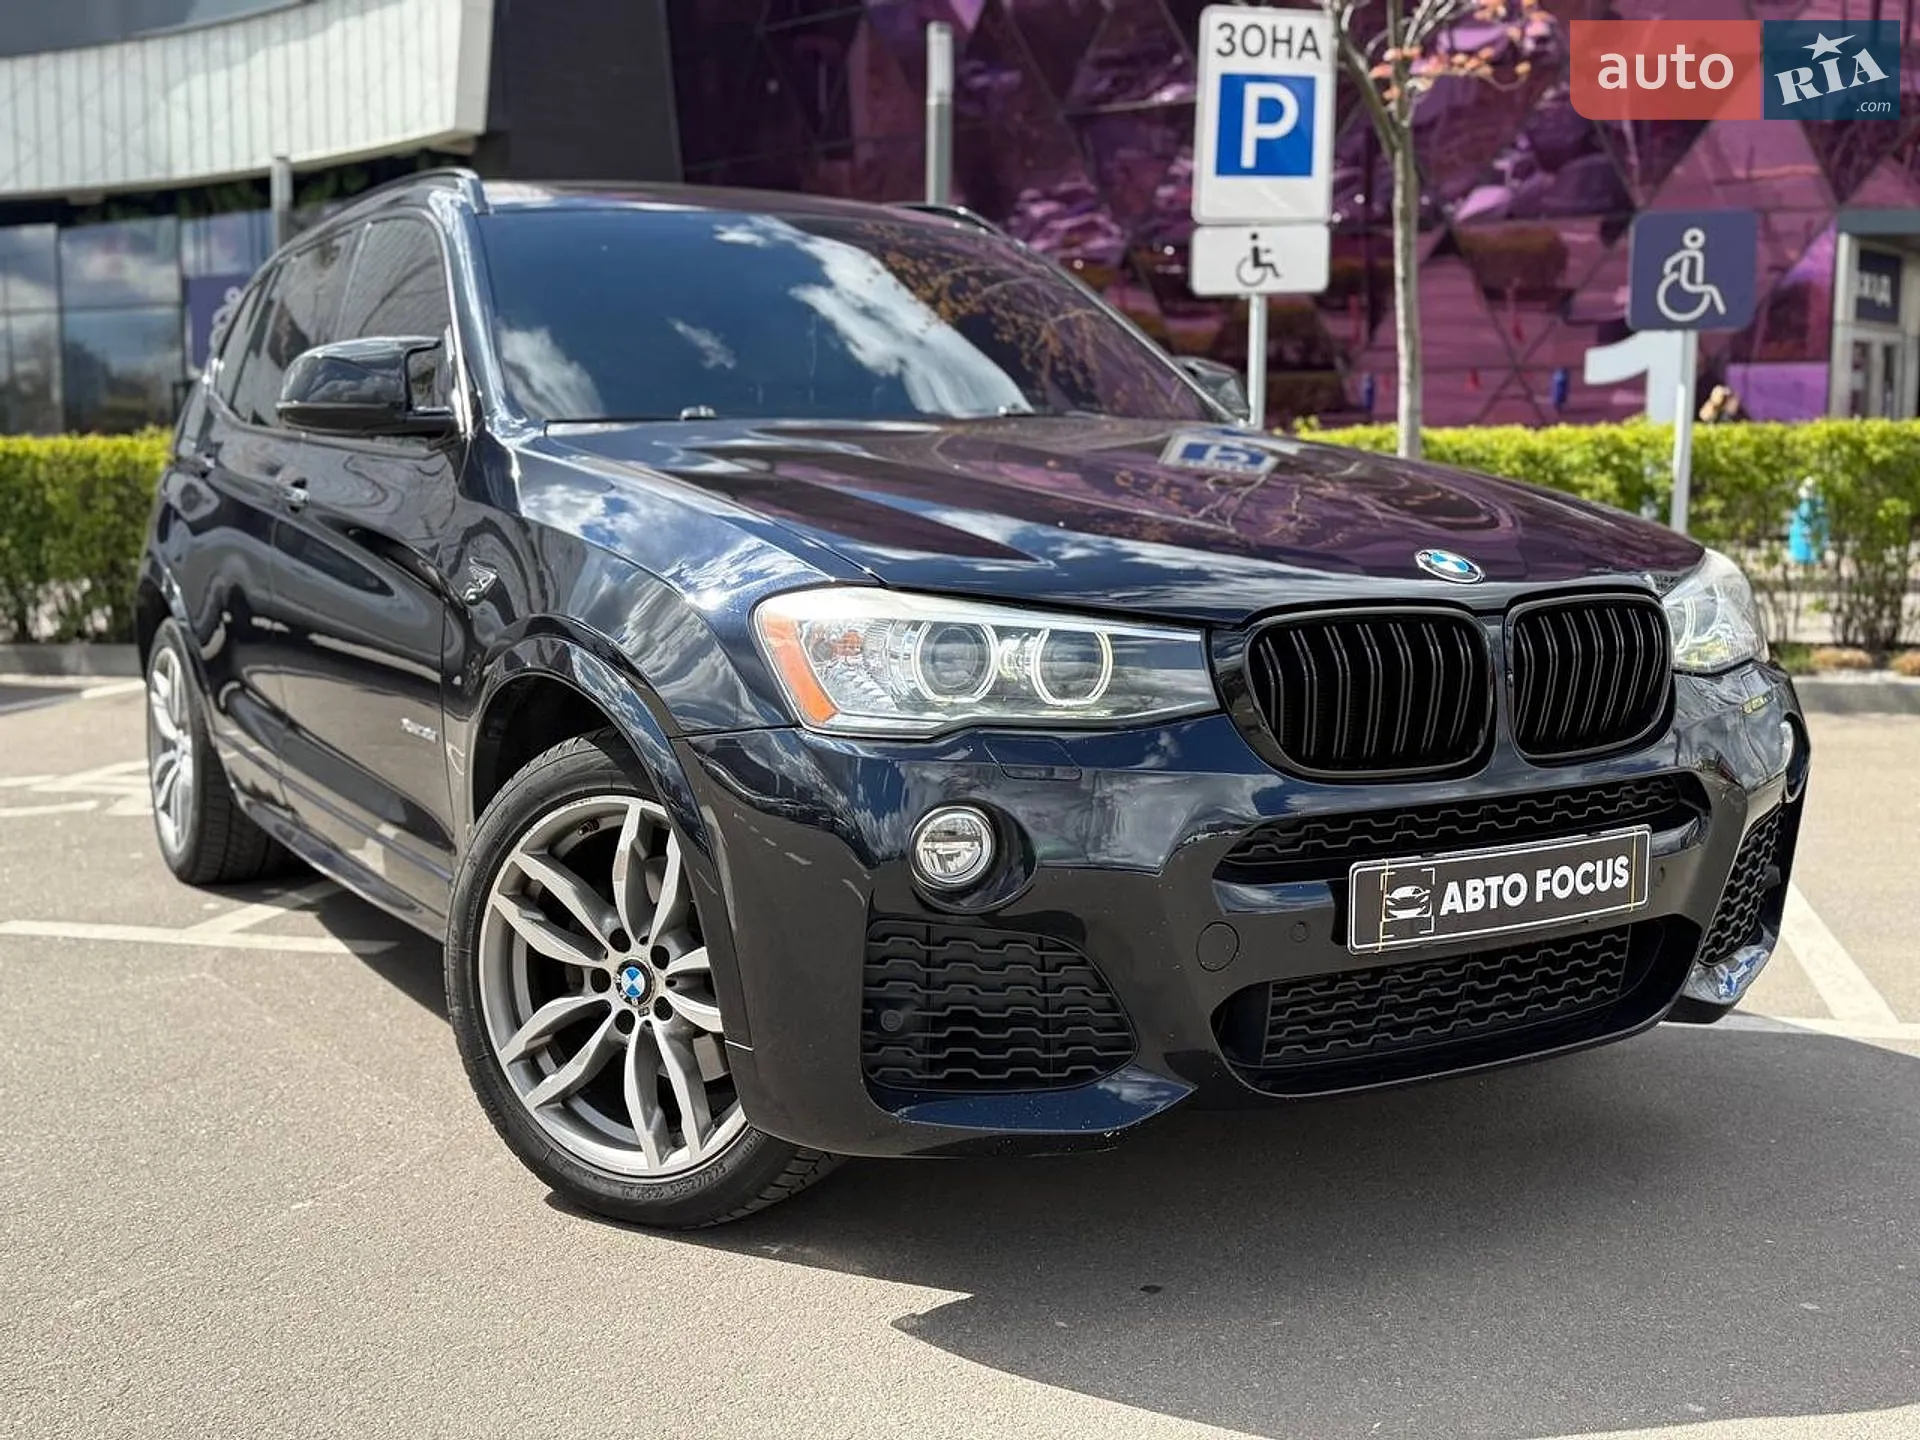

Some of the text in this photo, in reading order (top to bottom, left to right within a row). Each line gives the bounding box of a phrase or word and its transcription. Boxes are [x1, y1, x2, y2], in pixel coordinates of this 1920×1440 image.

[1216, 23, 1322, 61] ЗОНА
[1241, 81, 1299, 169] P
[1535, 856, 1630, 902] FOCUS
